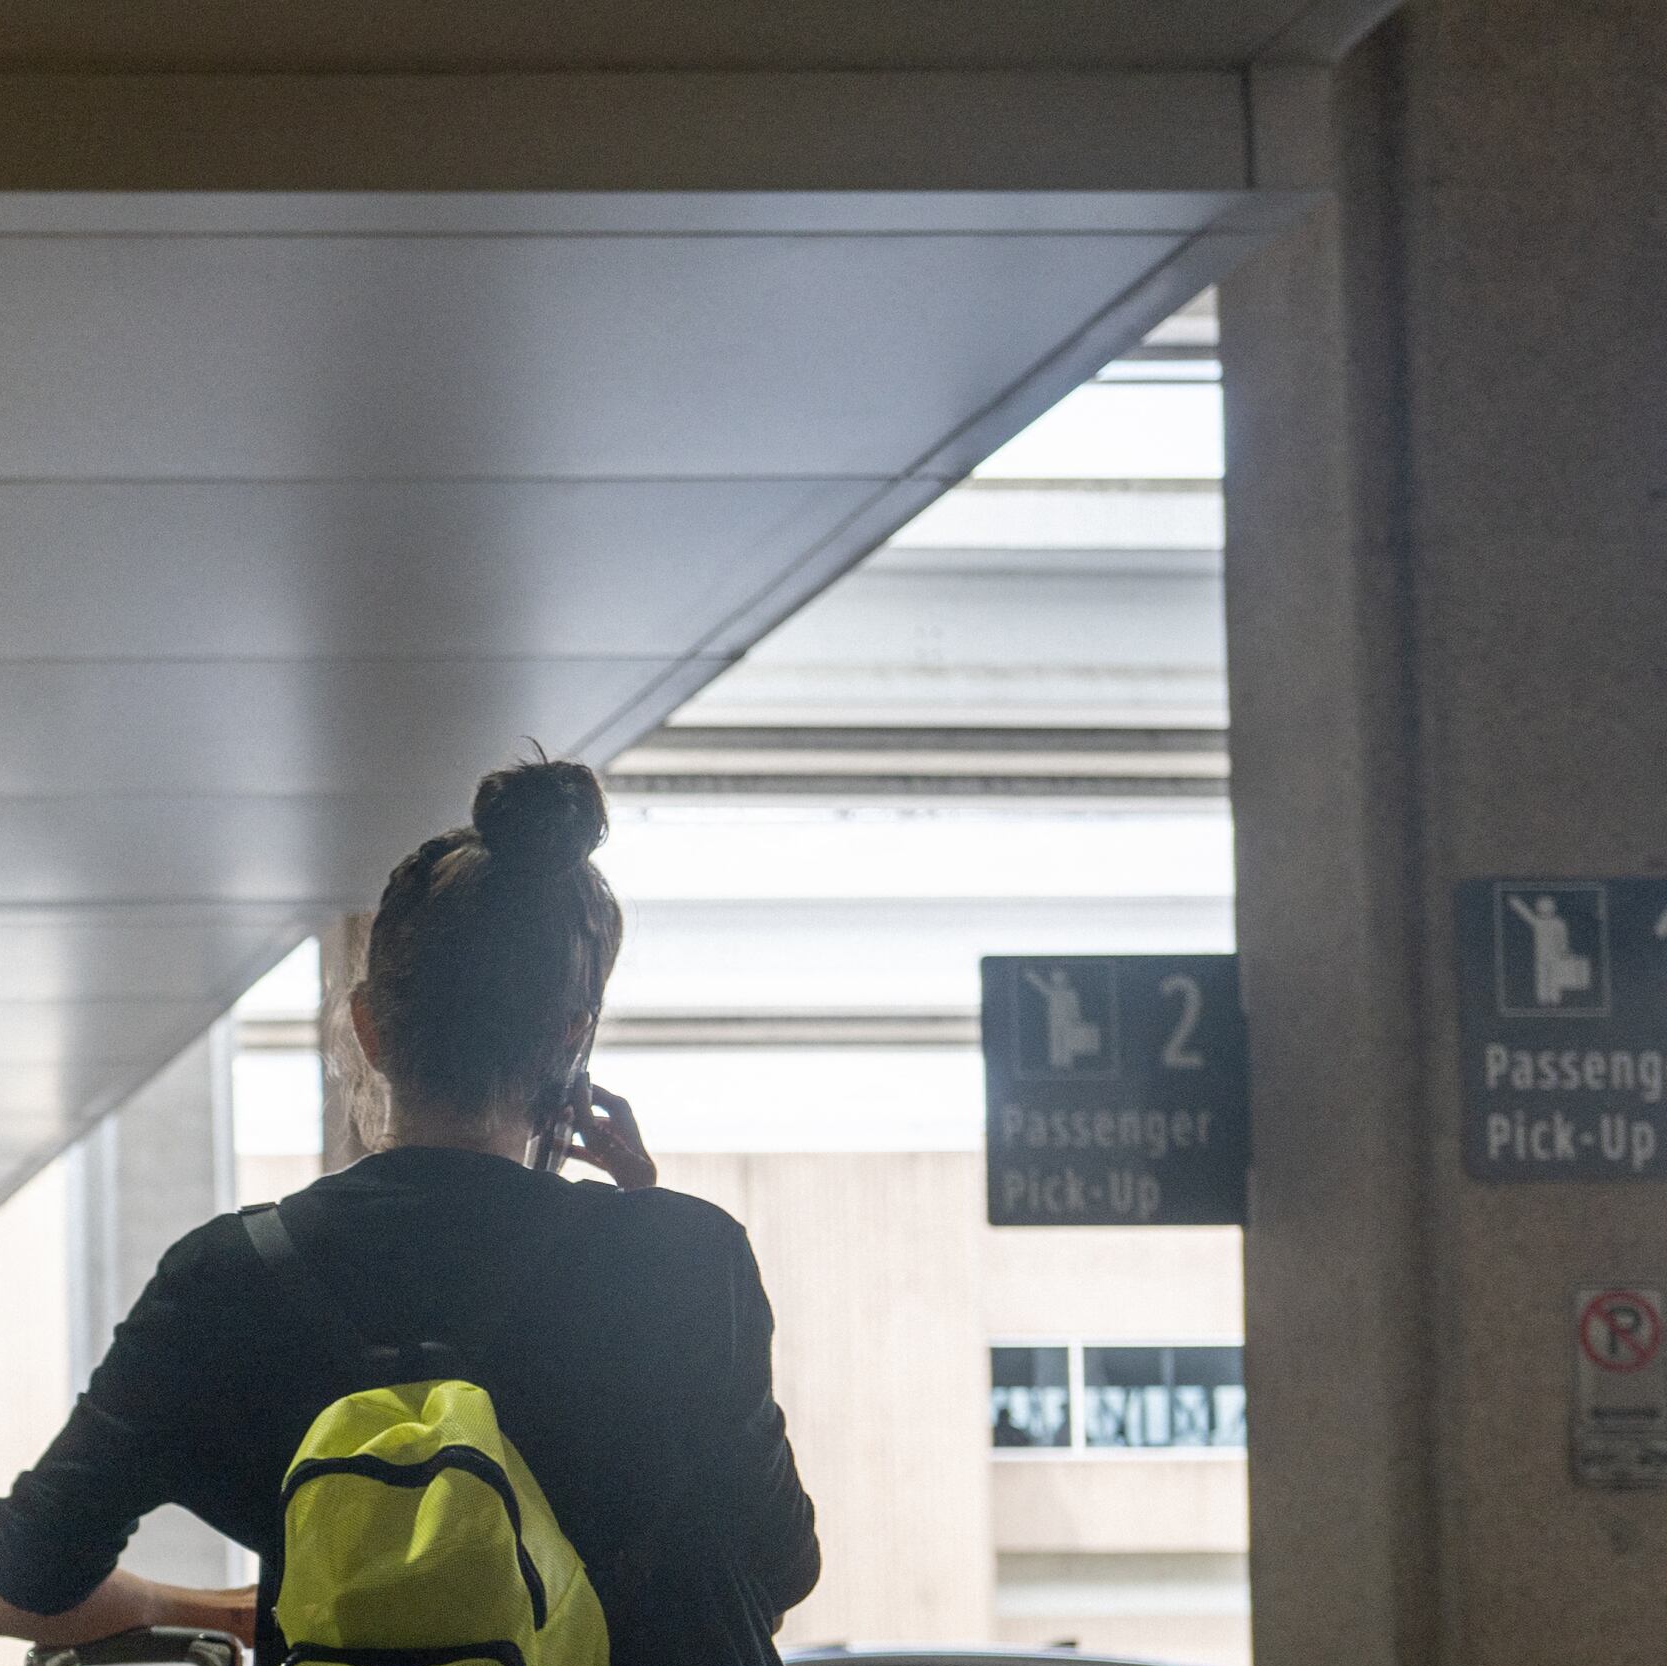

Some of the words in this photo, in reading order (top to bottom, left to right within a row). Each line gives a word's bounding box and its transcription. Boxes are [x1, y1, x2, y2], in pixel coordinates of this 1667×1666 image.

[1159, 974, 1204, 1070] 2
[1484, 1043, 1666, 1103] Passeng
[1002, 1104, 1210, 1159] Passenger
[1485, 1111, 1656, 1170] Pick-Up
[1002, 1169, 1161, 1219] Pick-Up
